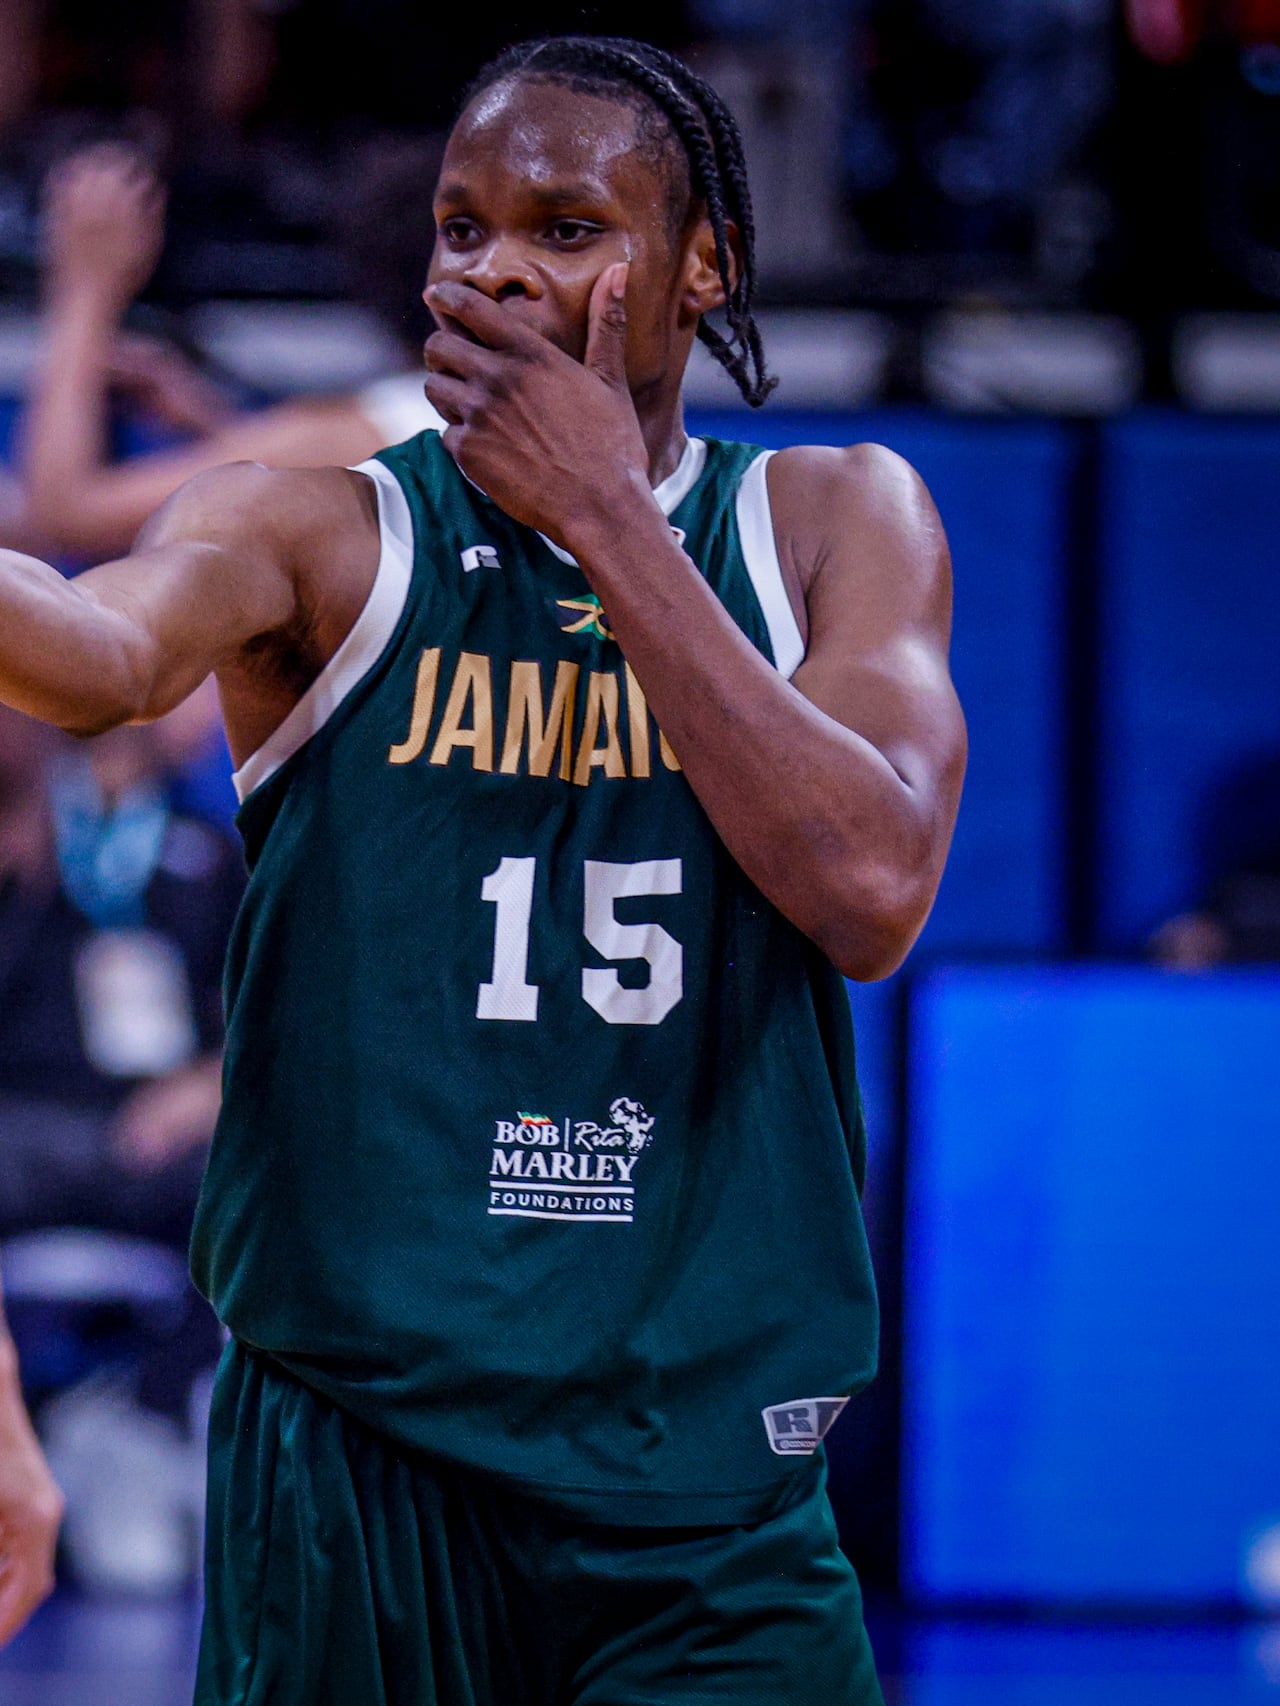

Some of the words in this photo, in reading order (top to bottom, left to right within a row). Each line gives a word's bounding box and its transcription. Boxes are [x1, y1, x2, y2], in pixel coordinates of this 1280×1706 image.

[388, 646, 684, 786] JAMAI
[475, 856, 684, 1025] 15
[493, 1119, 561, 1147] BOB
[574, 1120, 628, 1152] Rita
[488, 1147, 639, 1182] MARLEY
[490, 1191, 634, 1212] FOUNDATIONS
